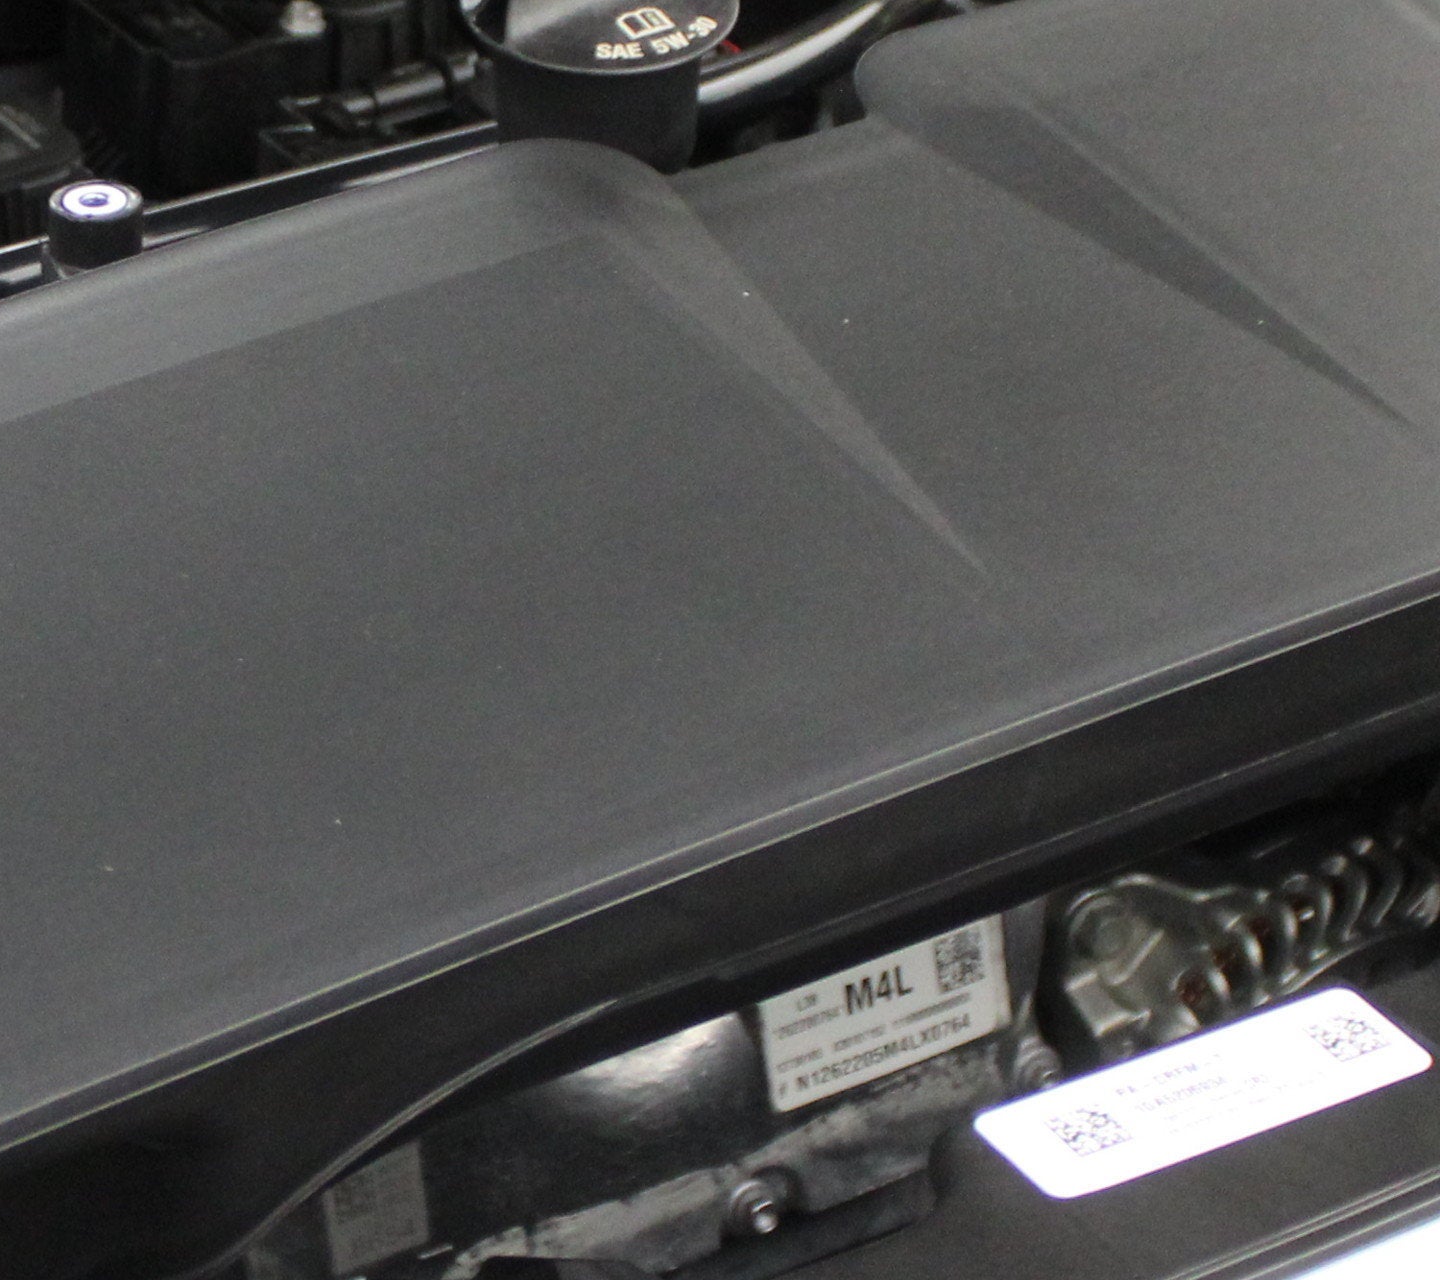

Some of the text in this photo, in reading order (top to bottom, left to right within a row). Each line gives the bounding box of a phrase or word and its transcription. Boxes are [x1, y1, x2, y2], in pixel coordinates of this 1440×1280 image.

[594, 15, 718, 60] SAE 5W-30
[843, 962, 914, 1015] M4L
